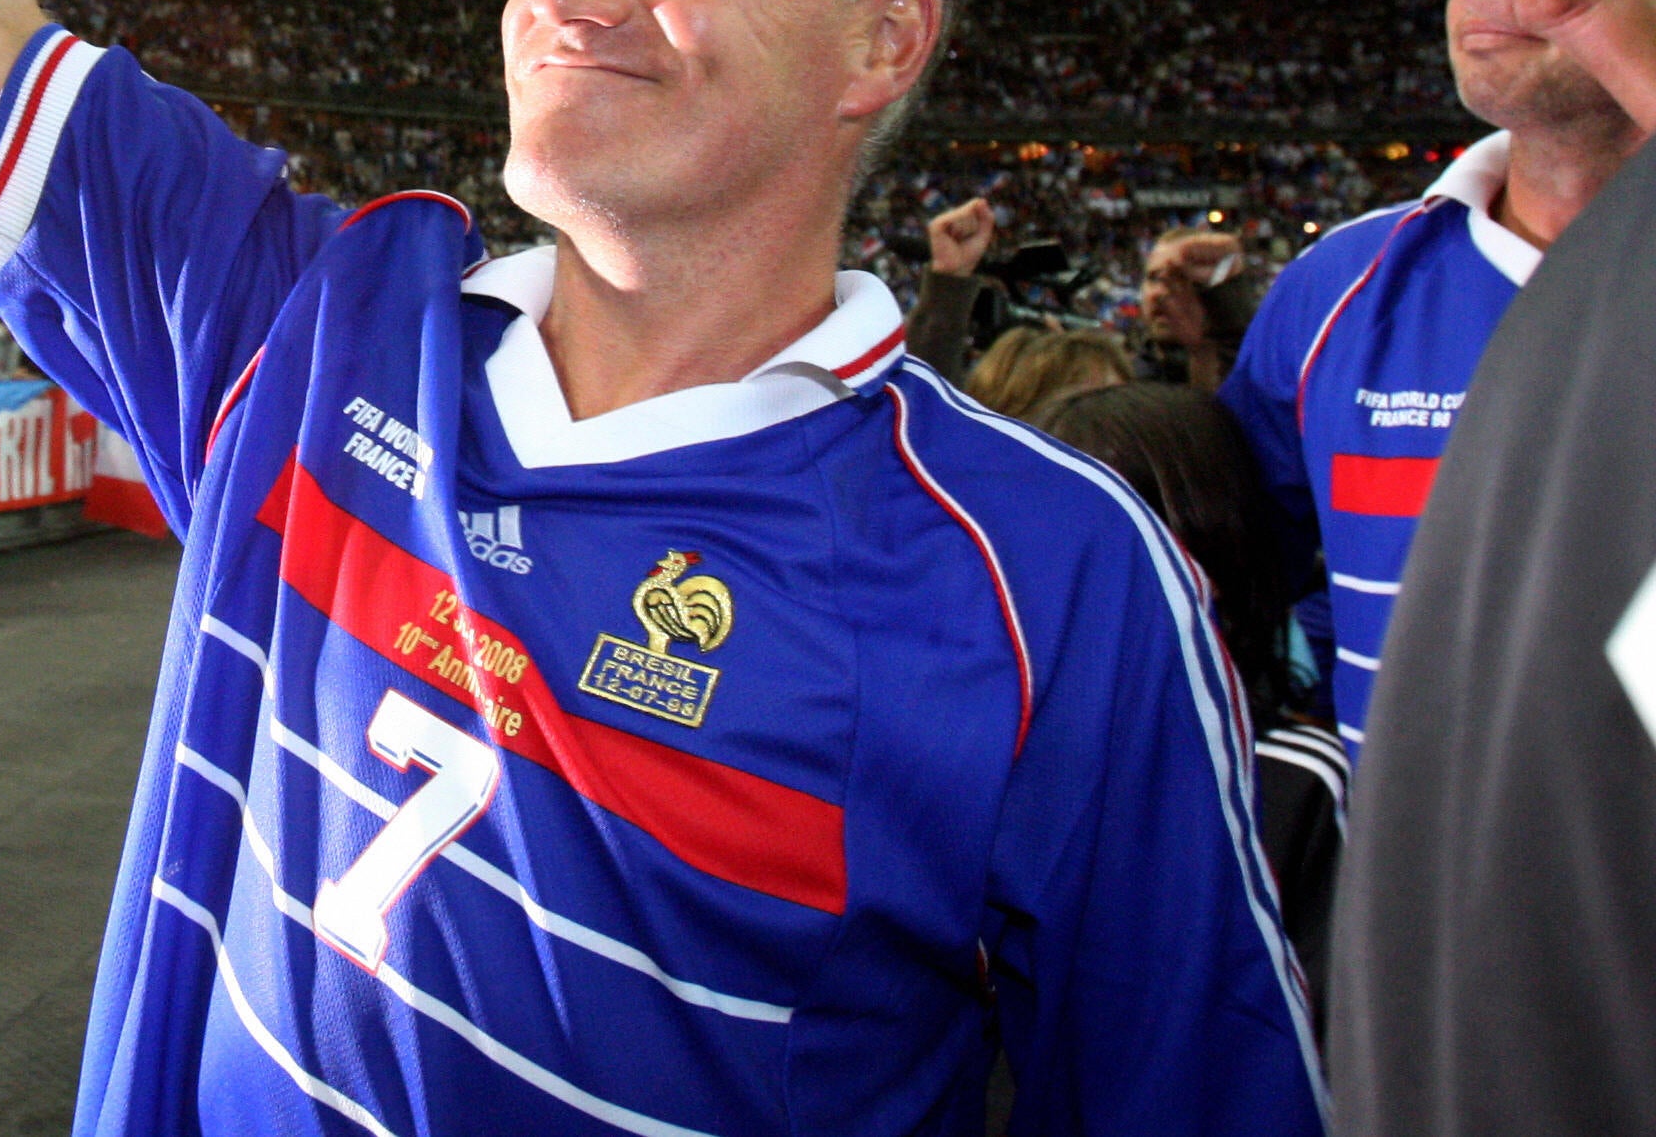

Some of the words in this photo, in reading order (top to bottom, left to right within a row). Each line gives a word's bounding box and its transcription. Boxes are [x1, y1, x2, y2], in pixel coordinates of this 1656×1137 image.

[343, 396, 385, 433] FIFA
[1355, 388, 1389, 409] FIFA
[1390, 391, 1440, 410] WORLD
[1370, 409, 1430, 428] FRANCE
[344, 431, 416, 490] FRANCE
[429, 589, 458, 625] 12
[473, 634, 530, 684] 2008
[601, 659, 699, 700] FRANCE
[612, 646, 697, 685] BRESIL
[593, 672, 695, 717] 12-07-98
[312, 687, 501, 976] 7
